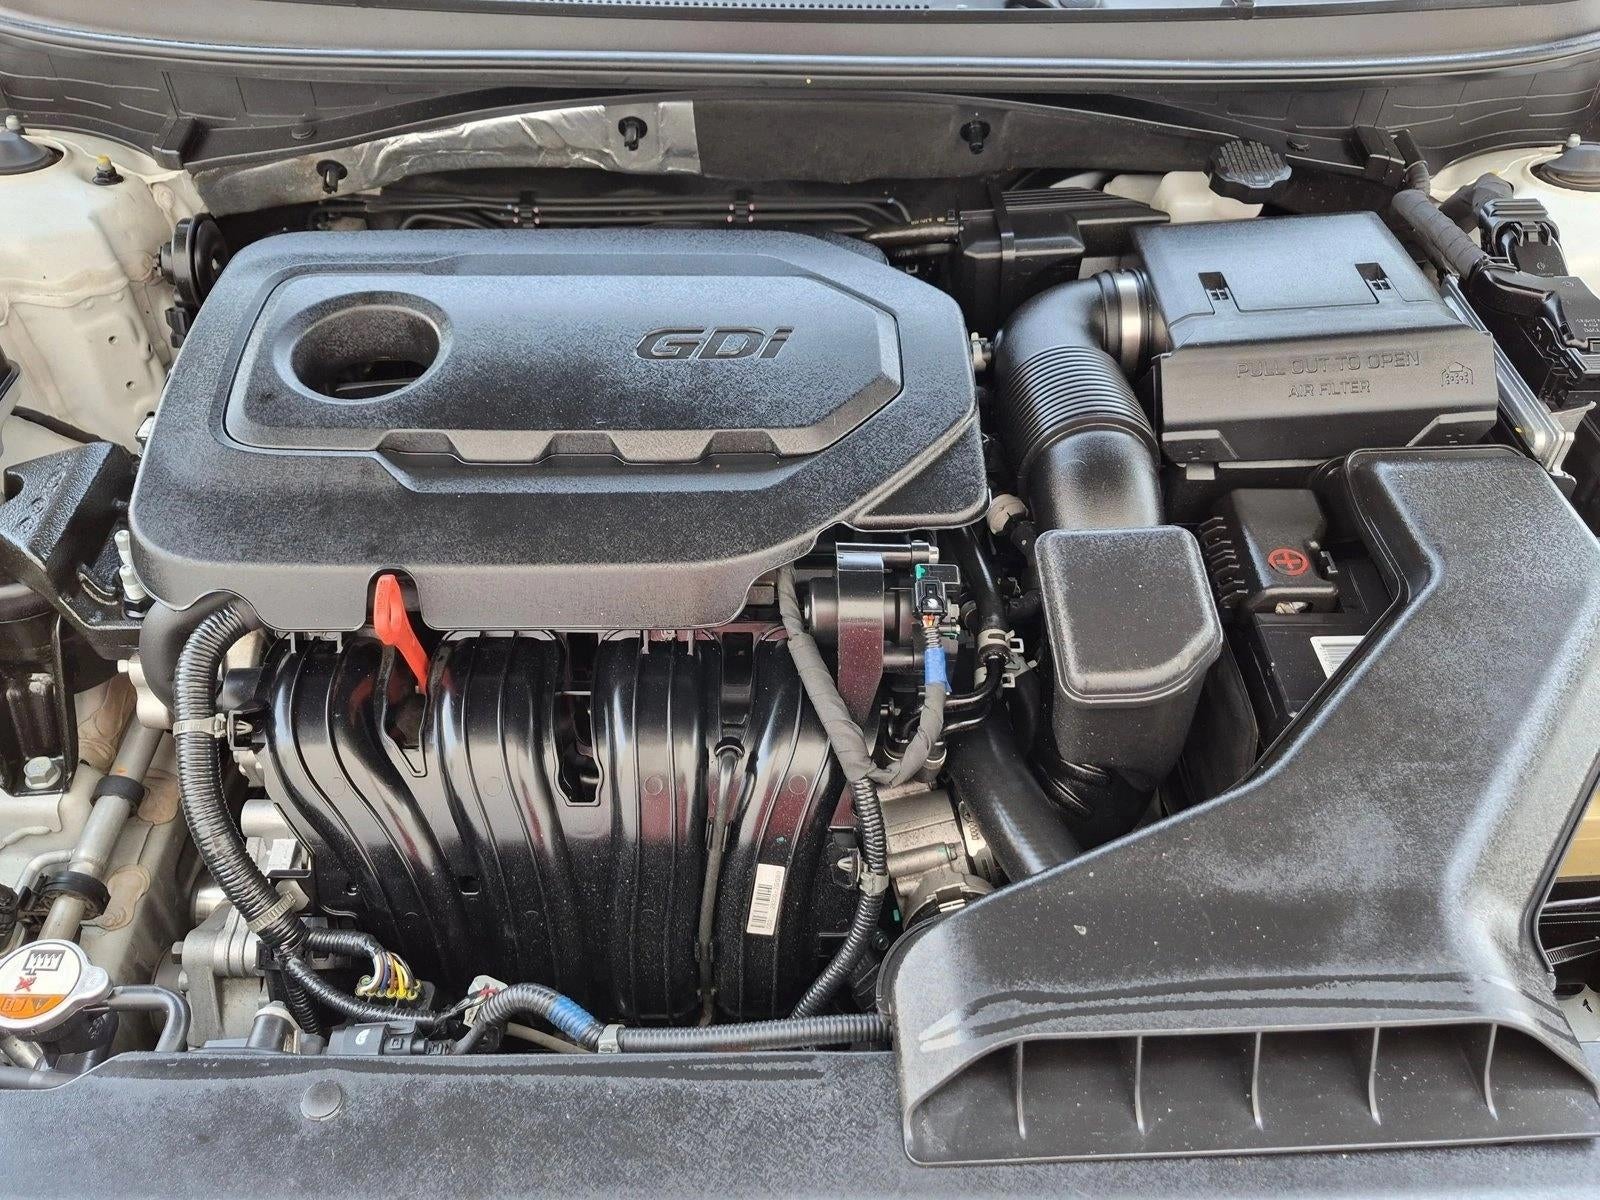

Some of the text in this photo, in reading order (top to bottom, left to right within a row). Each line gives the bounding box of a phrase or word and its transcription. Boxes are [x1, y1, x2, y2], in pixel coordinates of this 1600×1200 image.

[1235, 351, 1420, 378] PULL OUT TO OPEN
[1288, 380, 1371, 398] AIR FILTER
